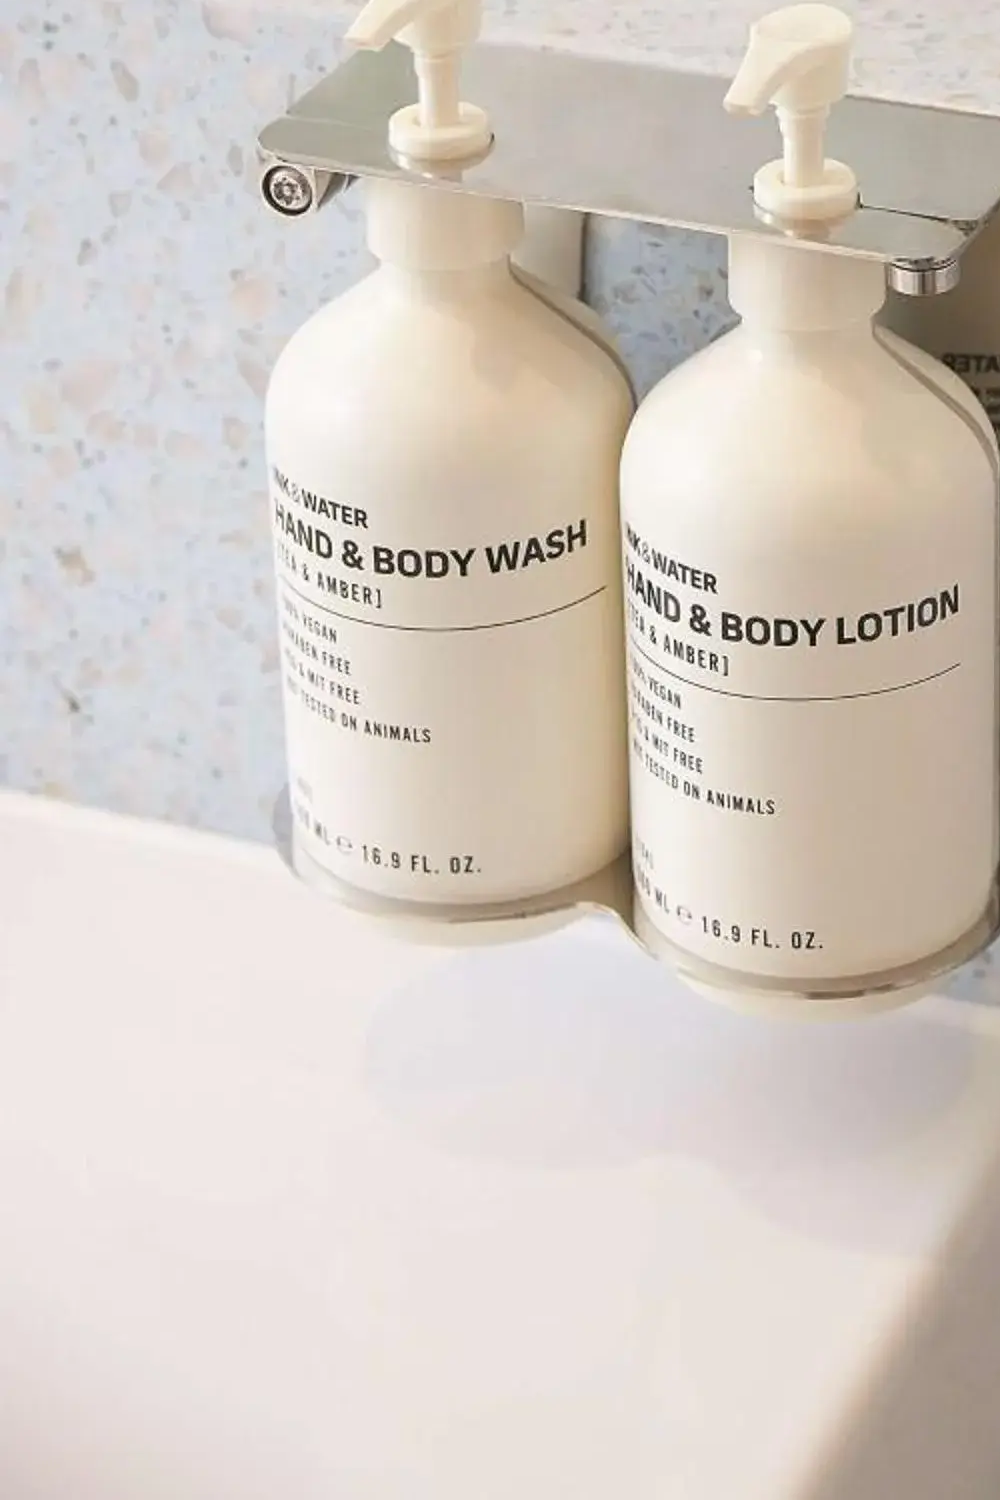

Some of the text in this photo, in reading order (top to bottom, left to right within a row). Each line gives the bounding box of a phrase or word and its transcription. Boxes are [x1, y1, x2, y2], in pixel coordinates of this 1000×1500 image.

[275, 498, 588, 579] HAND & BODY WASH
[317, 572, 382, 609] AMBER]
[626, 555, 959, 646] HAND & BODY LOTION
[302, 613, 338, 643] VEGAN
[322, 651, 351, 676] FREE
[664, 633, 729, 677] AMBER]
[330, 681, 360, 705] FREE
[648, 676, 682, 709] VEGAN
[301, 689, 432, 744] TESTED ON ANIMALS
[667, 716, 695, 743] FREE
[673, 747, 703, 775] FREE
[645, 753, 775, 815] TESTED ON ANIMALS
[362, 844, 401, 869] 16.9
[411, 854, 440, 875] FL.
[450, 856, 482, 875] OZ.
[701, 915, 741, 943] 16.9
[751, 927, 781, 949] FL.
[791, 931, 824, 950] OZ.
